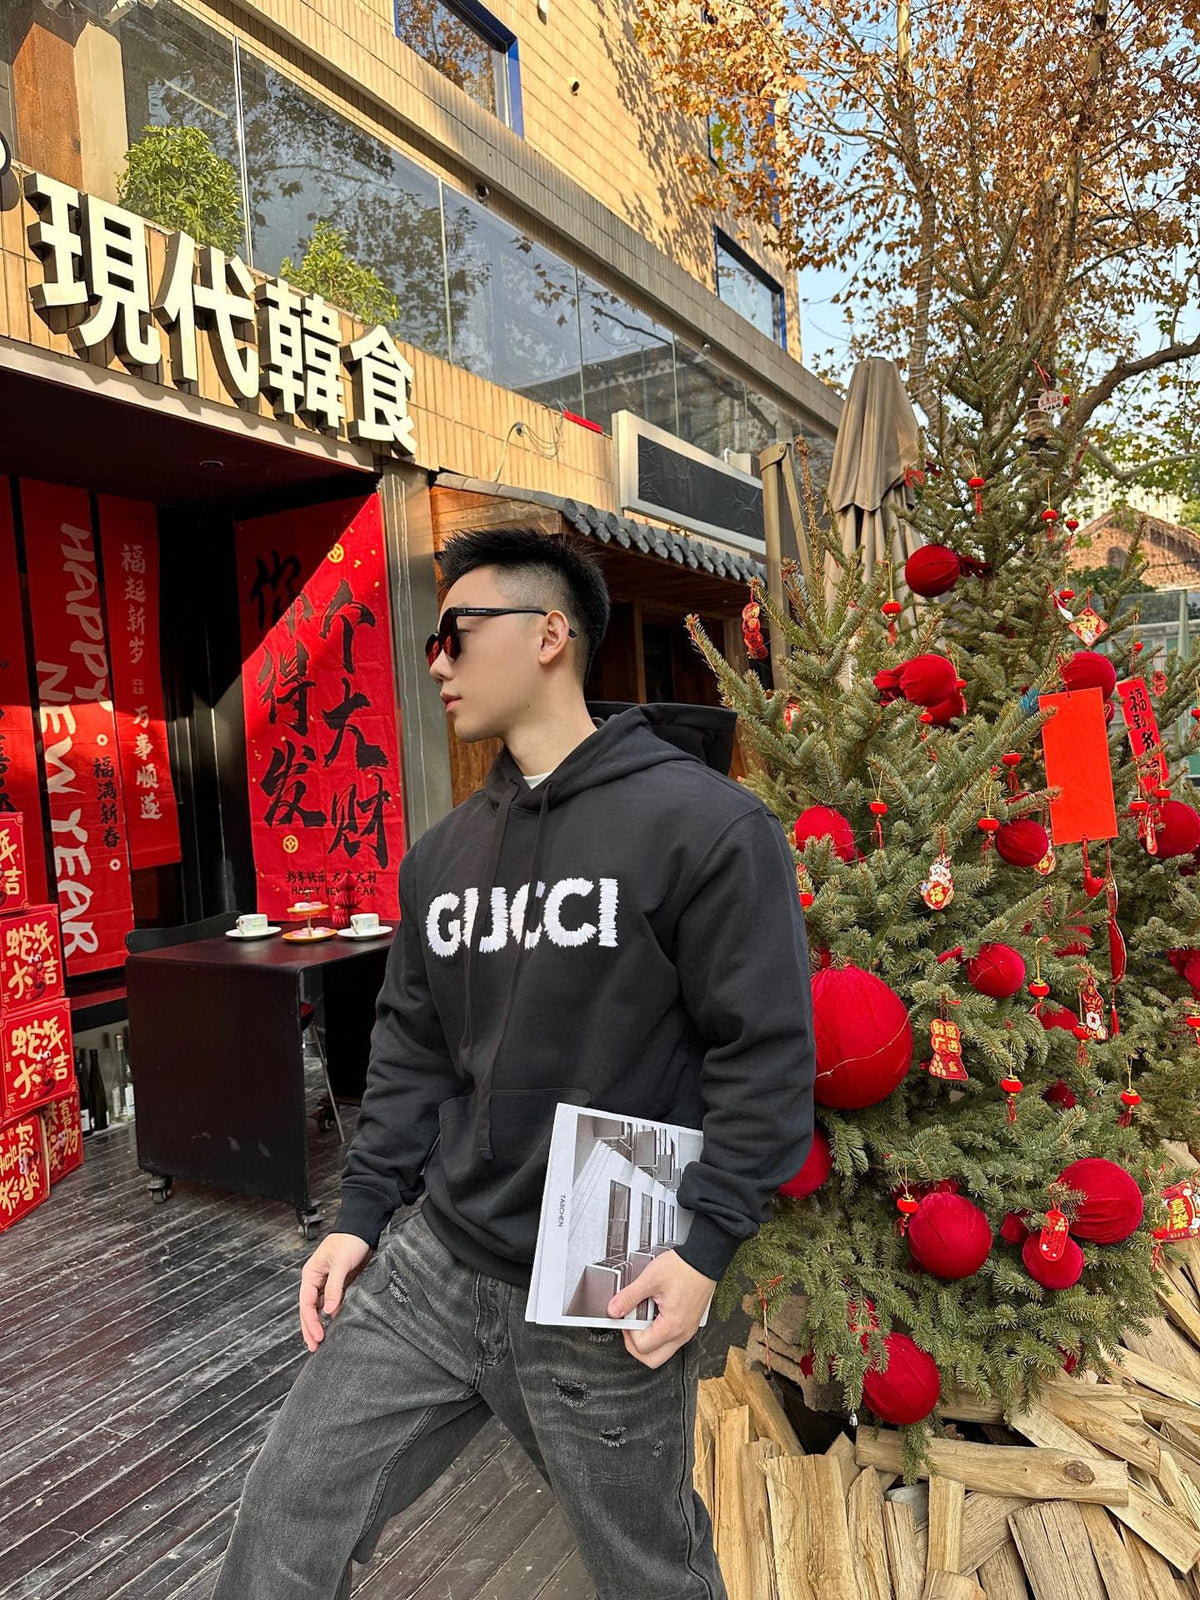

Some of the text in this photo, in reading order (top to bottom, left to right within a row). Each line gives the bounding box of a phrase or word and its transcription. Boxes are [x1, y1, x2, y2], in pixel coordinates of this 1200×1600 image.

[26, 171, 417, 456] 現代韓食
[121, 544, 147, 664] 福起新岁
[36, 523, 113, 958] HAPPY NEW YEAR
[133, 705, 163, 820] 万事顺遂
[94, 756, 120, 848] 福满新春
[425, 877, 619, 957] GUCCI
[558, 1194, 566, 1227] TASCHEN
